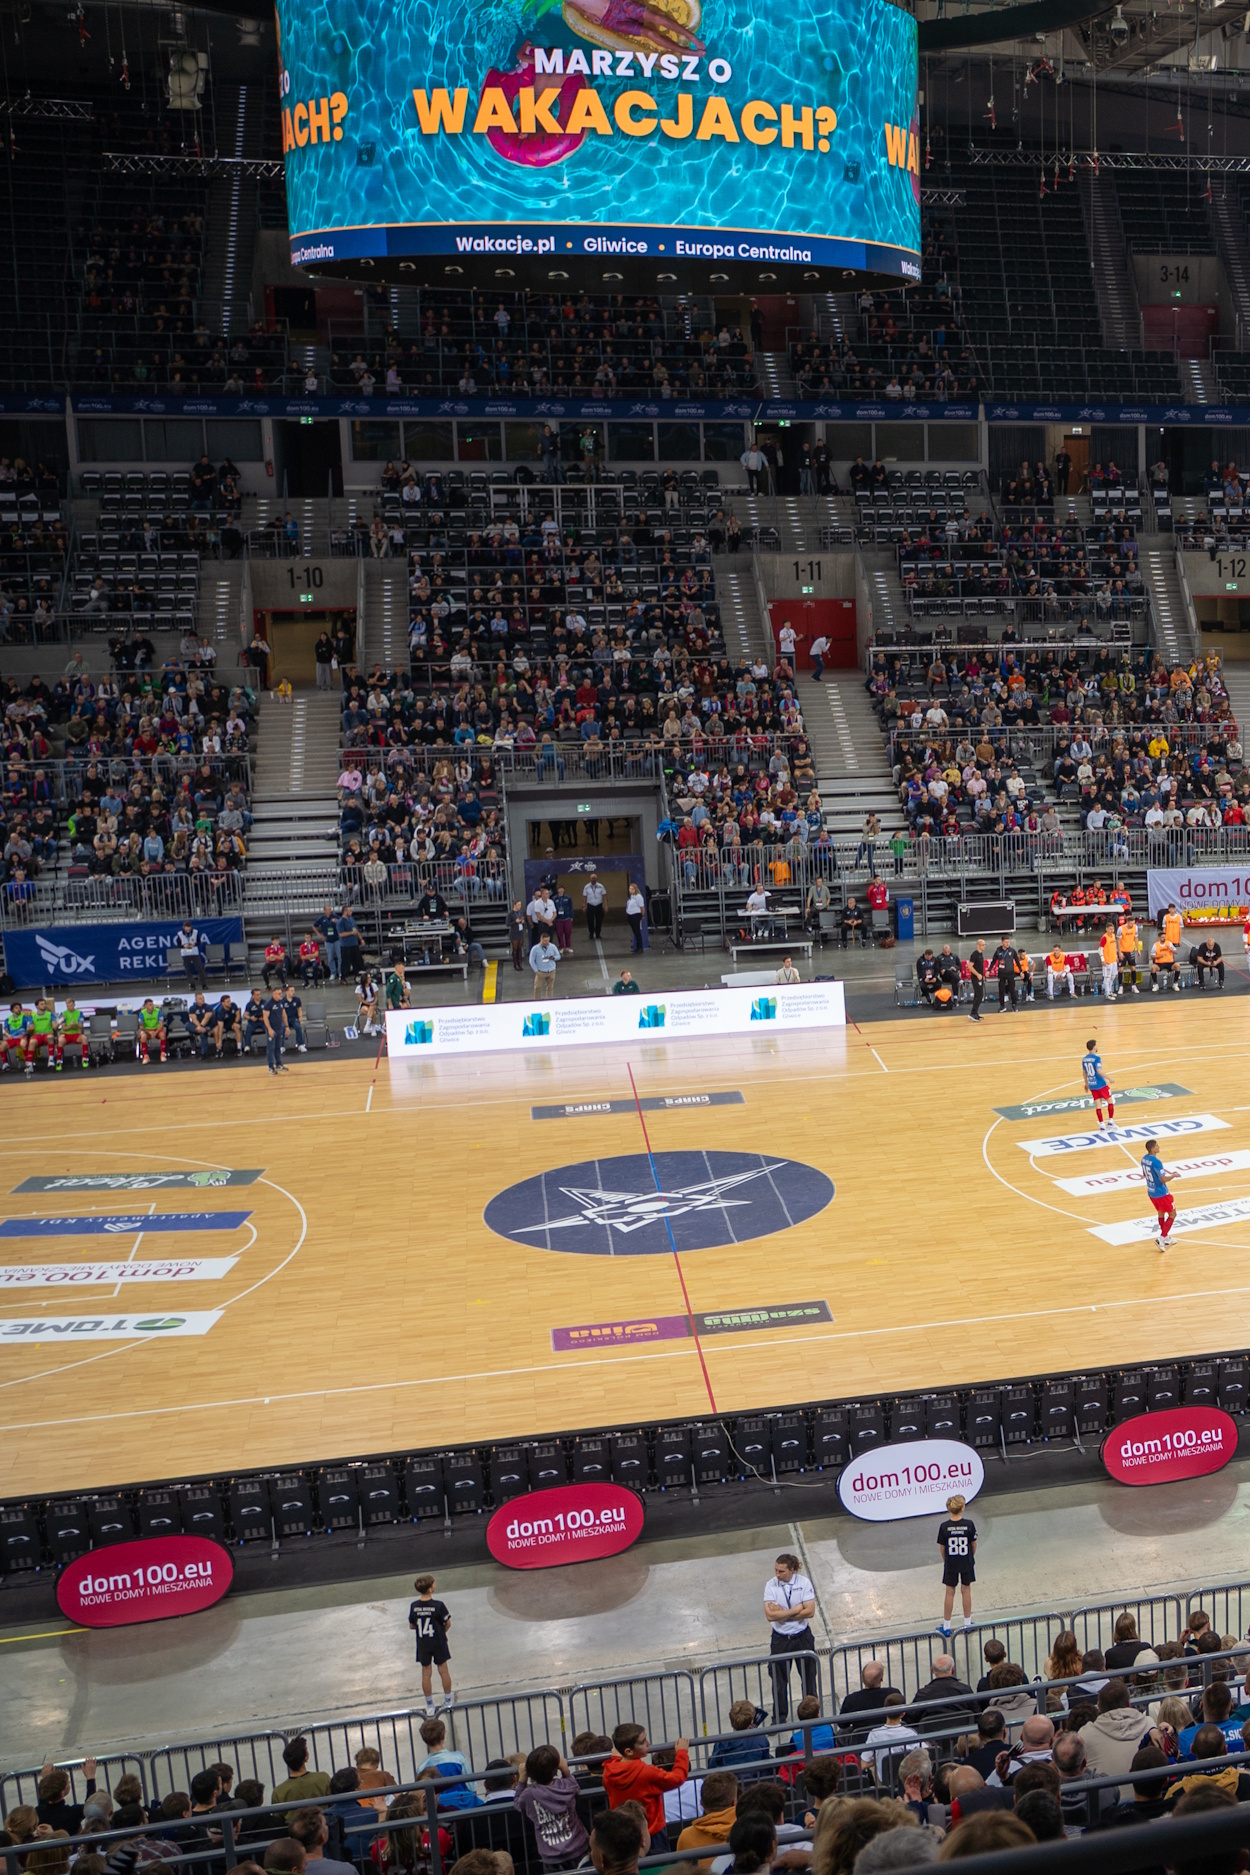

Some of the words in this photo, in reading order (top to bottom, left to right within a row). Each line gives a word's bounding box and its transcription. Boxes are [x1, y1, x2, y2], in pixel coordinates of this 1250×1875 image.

[534, 48, 702, 81] MARZYSZ
[708, 58, 732, 84] O
[413, 87, 838, 153] WAKACJACH?
[456, 235, 555, 255] Wakacje.pl
[583, 238, 648, 254] Gliwice
[675, 242, 735, 261] Europa
[738, 243, 812, 263] Centralna
[1160, 266, 1189, 283] 3-14
[287, 567, 324, 588] 1-10
[793, 561, 822, 580] 1-11
[1216, 558, 1246, 578] 1-12
[1179, 899, 1209, 909] NOWE
[1212, 899, 1240, 907] DOMY
[117, 933, 211, 951] AGENA
[438, 1016, 485, 1024] Przedsiębiorstwo
[439, 1023, 490, 1031] Zagospodarowania
[439, 1030, 465, 1038] Odpadów
[1084, 1062, 1095, 1077] 10
[565, 1103, 611, 1113] CHAPS
[664, 1095, 710, 1105] CHAPS
[1042, 1120, 1203, 1150] GLIWICE
[1085, 1158, 1233, 1188] dom10.eu
[1142, 1164, 1154, 1183] 15
[85, 1213, 215, 1224] Apartamenty
[4, 1265, 95, 1274] MIESZKANIA
[105, 1262, 153, 1270] DOMY
[154, 1260, 202, 1268] NOWE
[0, 1319, 128, 1336] TOME
[1120, 1427, 1222, 1458] dom100.eu
[1122, 1456, 1147, 1467] NOWE
[1149, 1451, 1172, 1463] DOMY
[1178, 1442, 1223, 1458] MIESZKANIA
[852, 1462, 972, 1492] dom100.eu
[853, 1492, 882, 1504] NOWE
[885, 1487, 912, 1499] DOMY
[919, 1478, 973, 1494] MIESZKANIA
[506, 1507, 625, 1538] dom100.eu
[508, 1537, 536, 1549] NOWE
[538, 1532, 565, 1545] DOMY
[572, 1522, 626, 1538] MIESZKANIA
[948, 1536, 968, 1556] 88
[79, 1561, 212, 1595] dom100.eu
[80, 1593, 112, 1606] NOWE
[114, 1588, 145, 1601] DOMY
[152, 1577, 213, 1595] MIESZKANIA
[417, 1617, 435, 1638] 14
